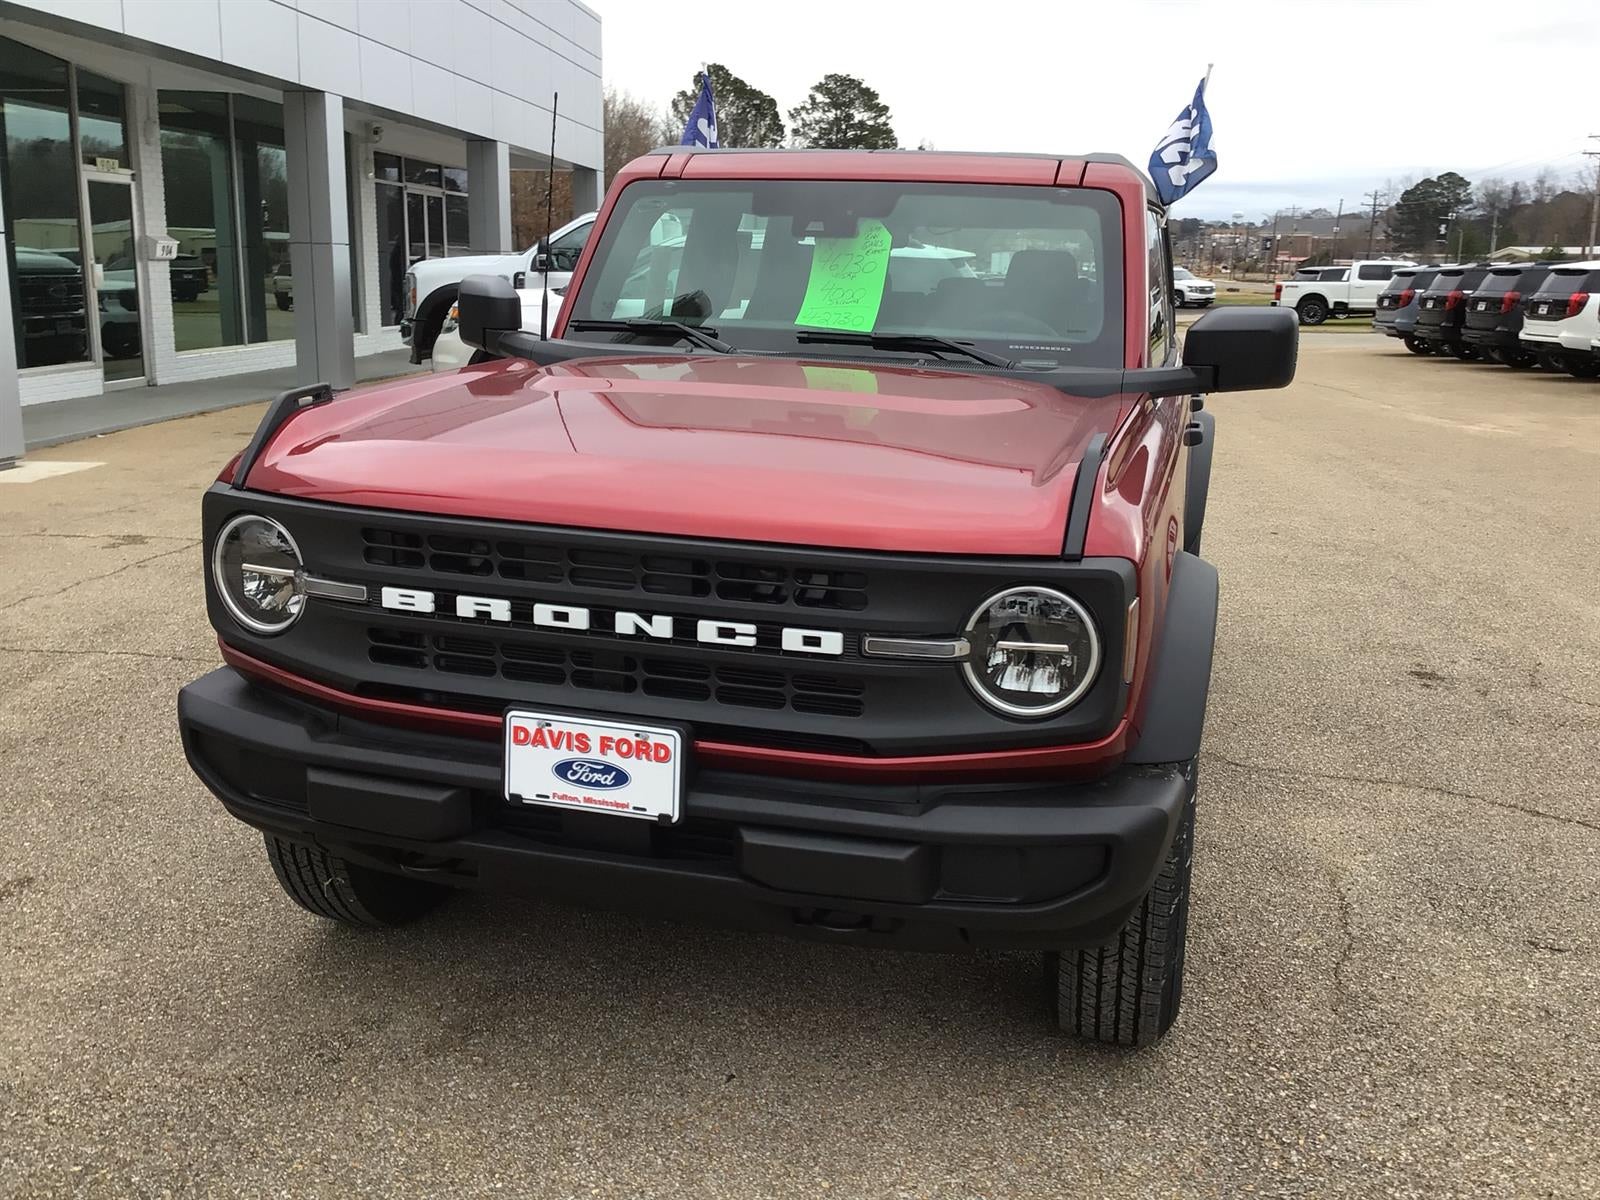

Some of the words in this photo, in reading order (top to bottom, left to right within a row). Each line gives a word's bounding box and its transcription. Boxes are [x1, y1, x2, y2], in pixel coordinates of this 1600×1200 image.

[381, 586, 844, 655] BRONCO
[512, 725, 591, 753] DAVIS
[600, 735, 672, 764] FORD
[566, 761, 616, 786] Ford
[552, 792, 582, 804] Fulton,
[583, 796, 630, 810] Mississippi
